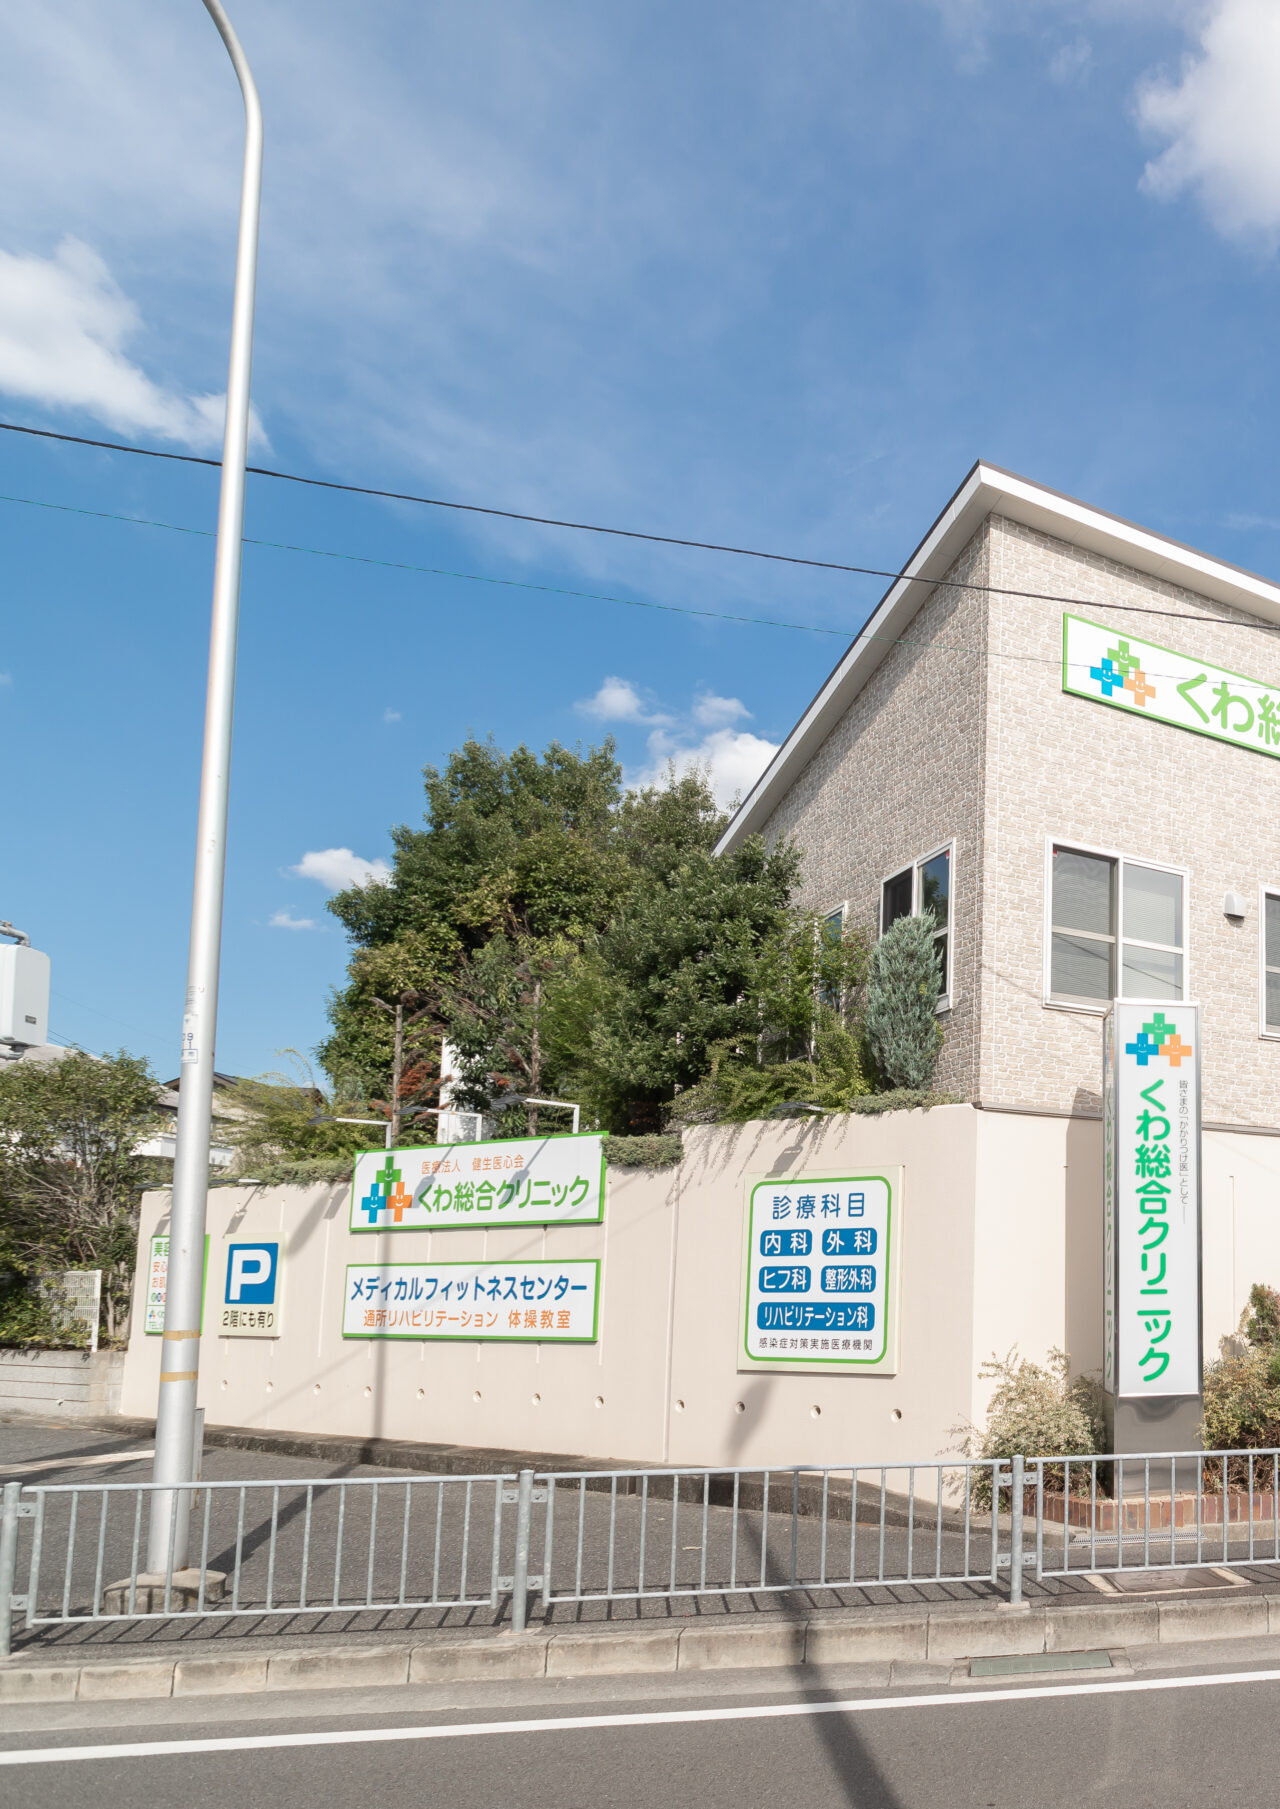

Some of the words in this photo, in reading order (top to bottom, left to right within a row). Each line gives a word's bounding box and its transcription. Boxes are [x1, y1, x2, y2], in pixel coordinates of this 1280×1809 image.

[421, 1158, 461, 1174] 医療法人
[472, 1154, 524, 1171] 健生医心会
[418, 1175, 590, 1213] くわ総合クリニック
[772, 1192, 865, 1220] 診療科目
[826, 1230, 873, 1253] 外科
[1135, 1079, 1172, 1382] くわ総合クリニック
[765, 1231, 808, 1254] 内科
[229, 1249, 272, 1301] P
[763, 1268, 807, 1291] ヒフ科
[825, 1268, 872, 1291] 整形外科
[351, 1274, 588, 1301] メディカルフィットネスセンター
[222, 1310, 274, 1328] 2階にも有り
[363, 1309, 498, 1328] 通所リハビリテーション
[508, 1309, 571, 1329] 体操教室
[764, 1305, 869, 1329] リハビリテーション科
[759, 1337, 873, 1351] 感染症対策実施医療機関
